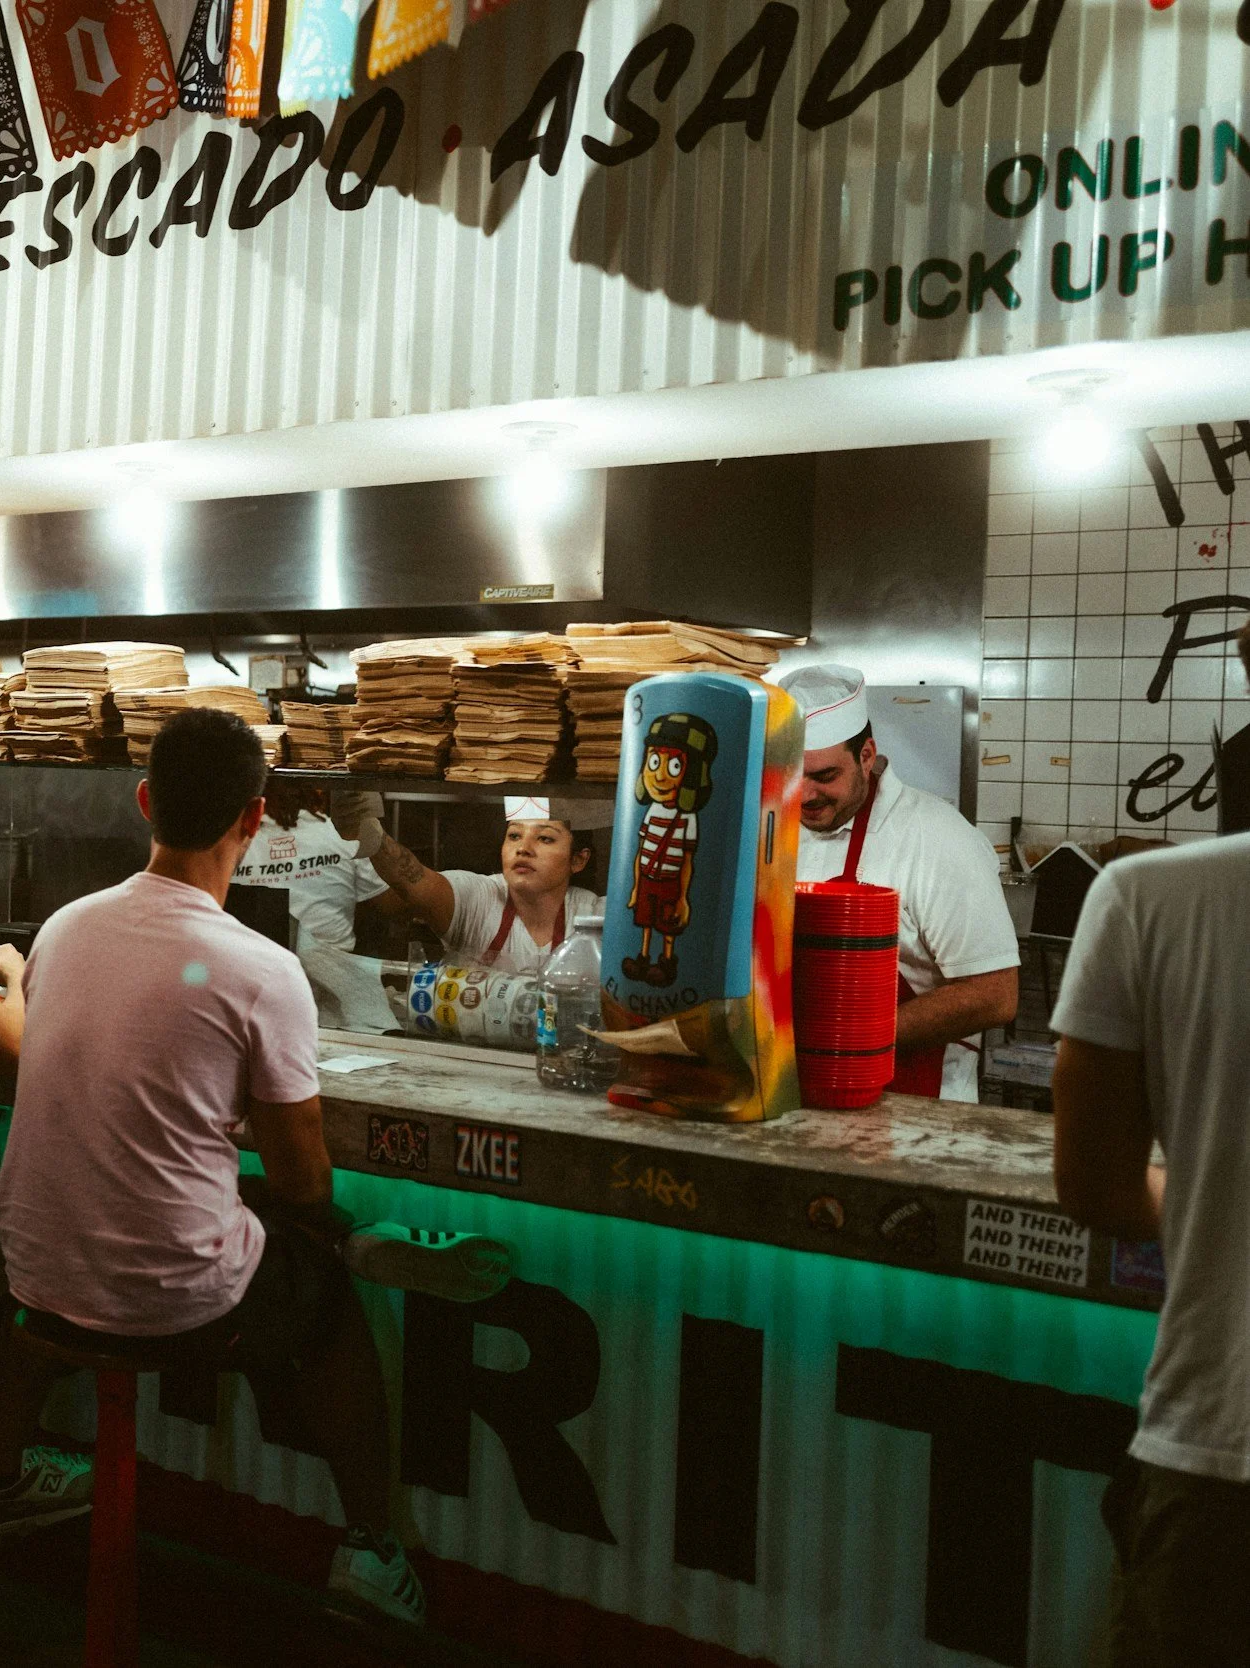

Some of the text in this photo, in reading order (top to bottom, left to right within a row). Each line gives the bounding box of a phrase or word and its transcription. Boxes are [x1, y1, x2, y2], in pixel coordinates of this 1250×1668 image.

[833, 248, 1022, 332] PICK
[1051, 229, 1175, 303] UP
[259, 861, 294, 876] TACO
[299, 853, 341, 871] STAND
[456, 1125, 519, 1185] ZKEE
[970, 1203, 1086, 1239] AND THEN?
[969, 1225, 1084, 1261] AND THEN?
[968, 1247, 1083, 1284] AND THEN?
